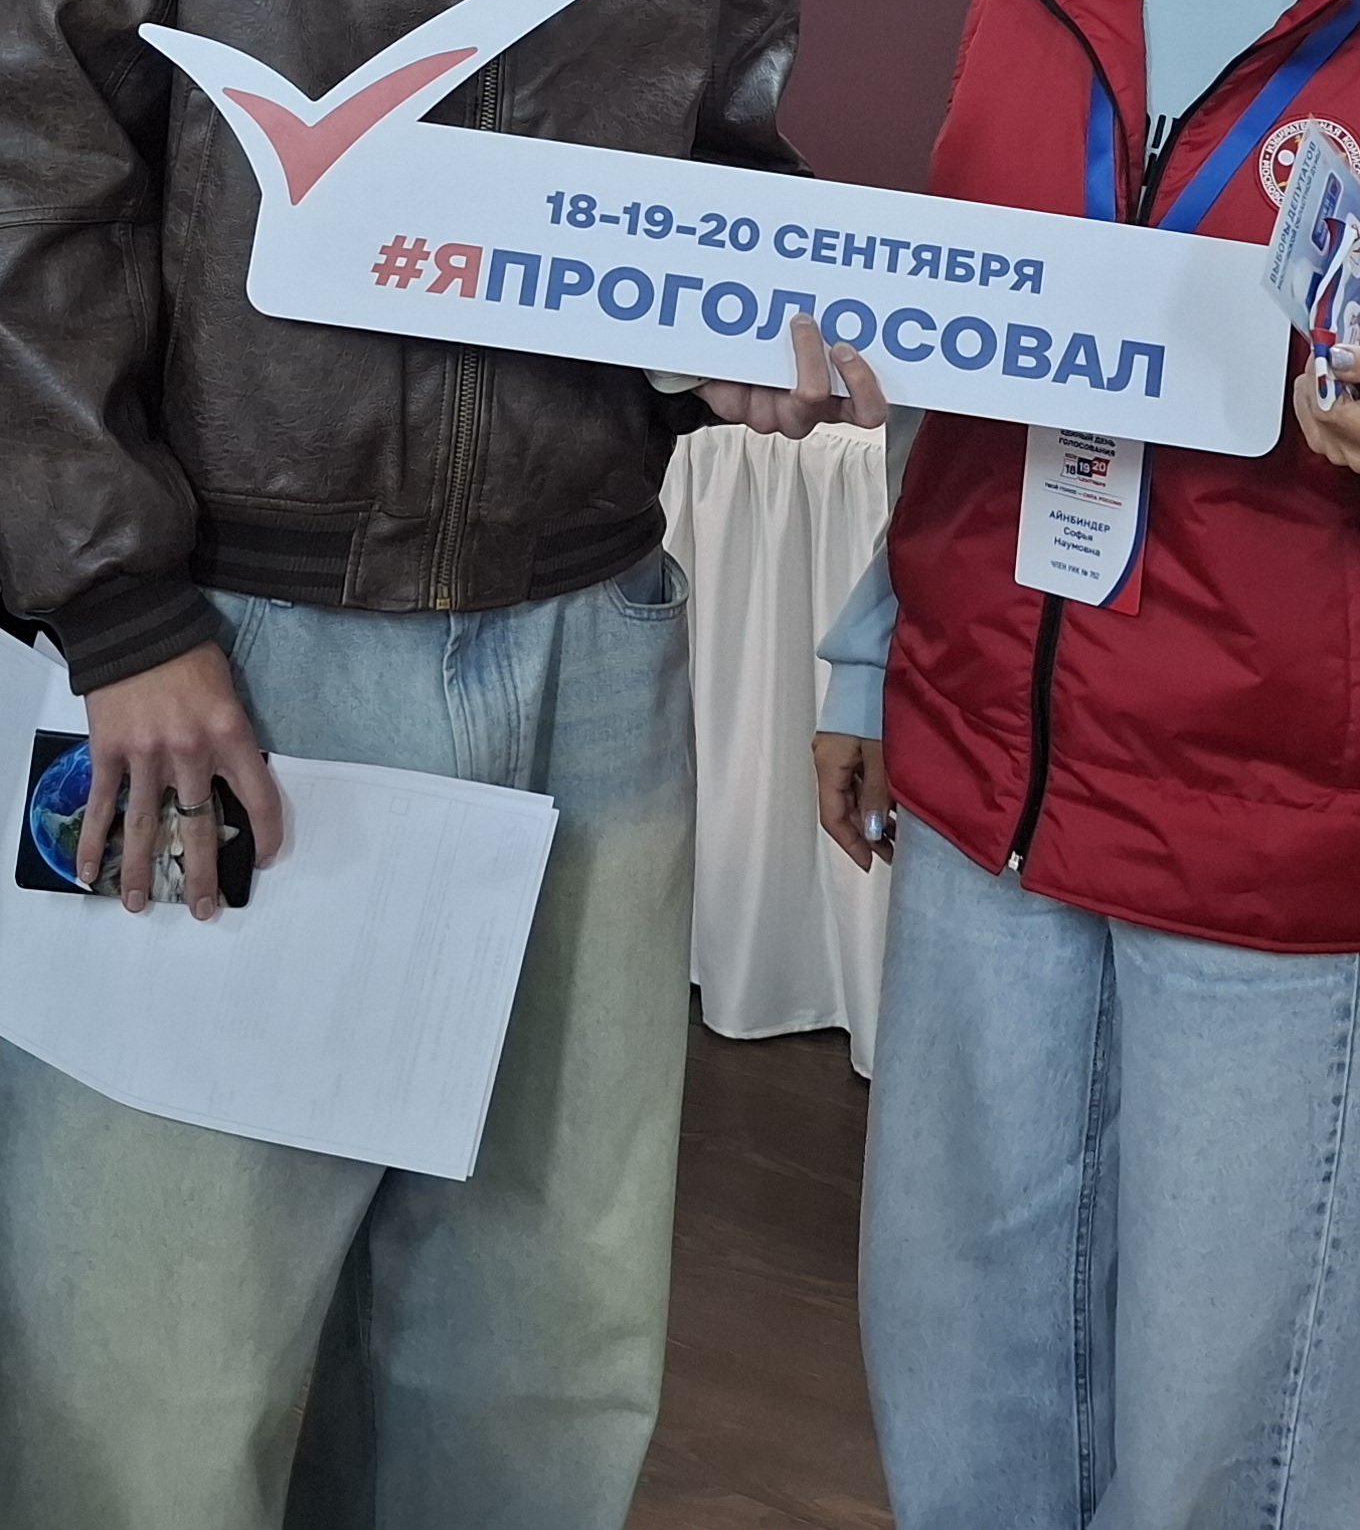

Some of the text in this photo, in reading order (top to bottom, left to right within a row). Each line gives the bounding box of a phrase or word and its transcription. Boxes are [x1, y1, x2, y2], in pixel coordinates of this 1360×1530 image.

[1270, 140, 1317, 284] ВЫБОРЫ ДЕПУТАТОВ
[546, 190, 1045, 295] 18-19-20 СЕНТЯБРЯ
[371, 234, 1166, 399] #ЯПРОГОЛОСОВАЛ
[1058, 437, 1116, 457] ГОЛОСОВАНИЯ
[1065, 460, 1106, 475] 18 19 20
[1049, 509, 1111, 533] АЙНБИНДЕР
[1063, 526, 1093, 541] Софья
[1053, 536, 1101, 557] Наумовна
